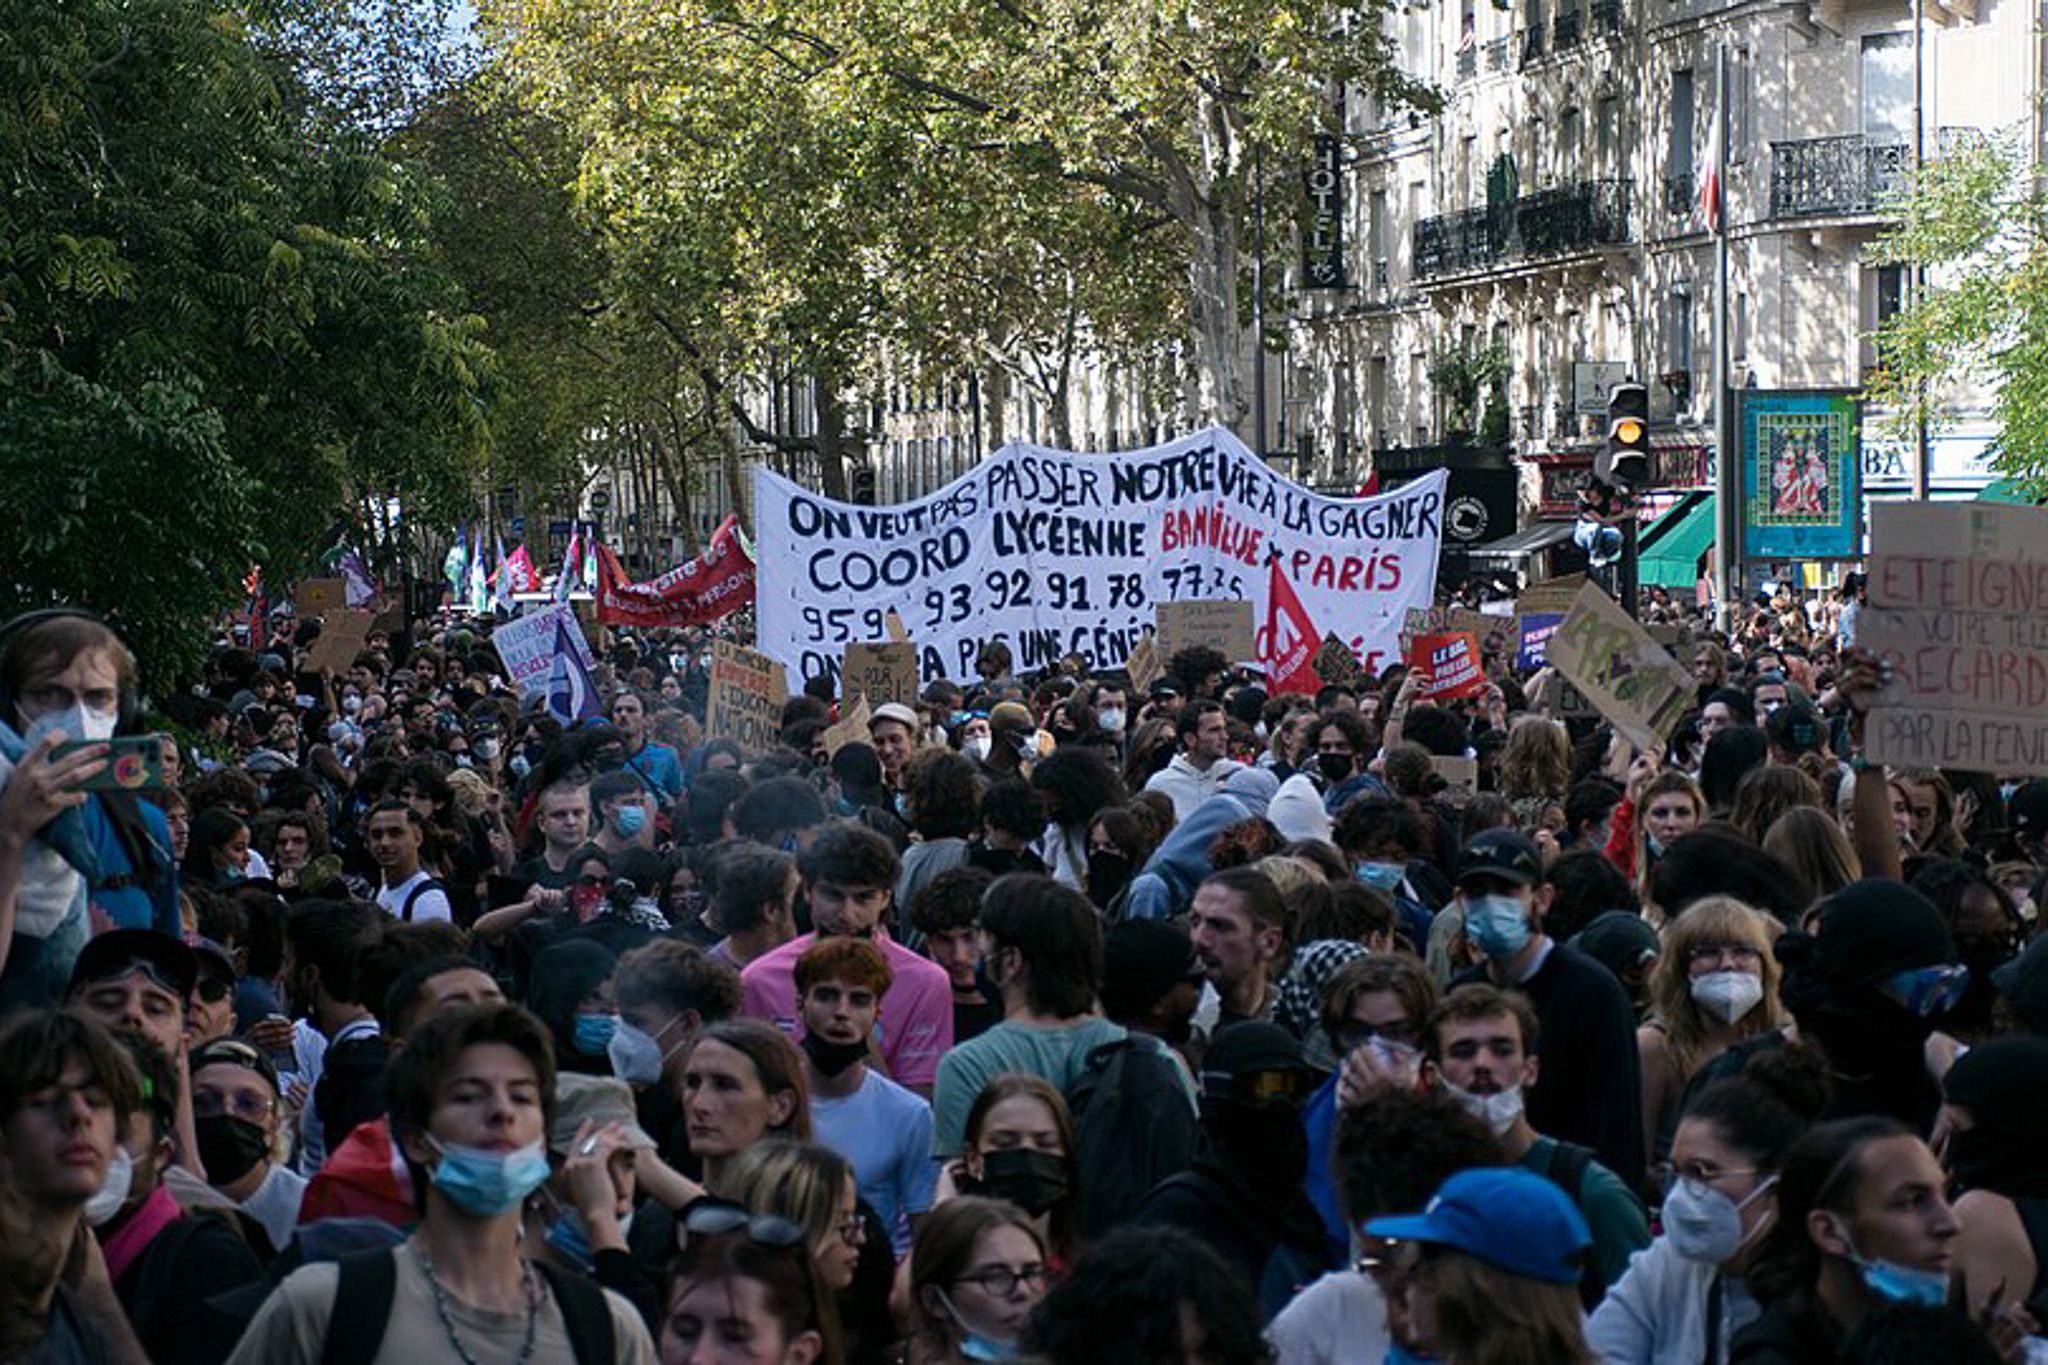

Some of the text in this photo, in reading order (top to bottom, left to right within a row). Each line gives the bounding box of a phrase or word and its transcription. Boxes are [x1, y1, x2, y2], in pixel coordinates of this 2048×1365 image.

[1309, 150, 1336, 251] HOTEL
[788, 496, 850, 539] ON
[857, 506, 927, 540] VEUT
[930, 481, 977, 526] PAS
[987, 457, 1100, 508] PASSER
[1110, 445, 1215, 505] NOTRE
[1218, 453, 1261, 510] VIE
[1260, 473, 1278, 518] À
[1283, 492, 1313, 535] LA
[1319, 492, 1440, 540] GAGNER
[808, 527, 971, 592] COORD
[993, 507, 1146, 557] LYCÉENNE
[1019, 629, 1062, 667] UNE
[1879, 713, 1936, 760] PAR
[1943, 718, 1972, 761] LA
